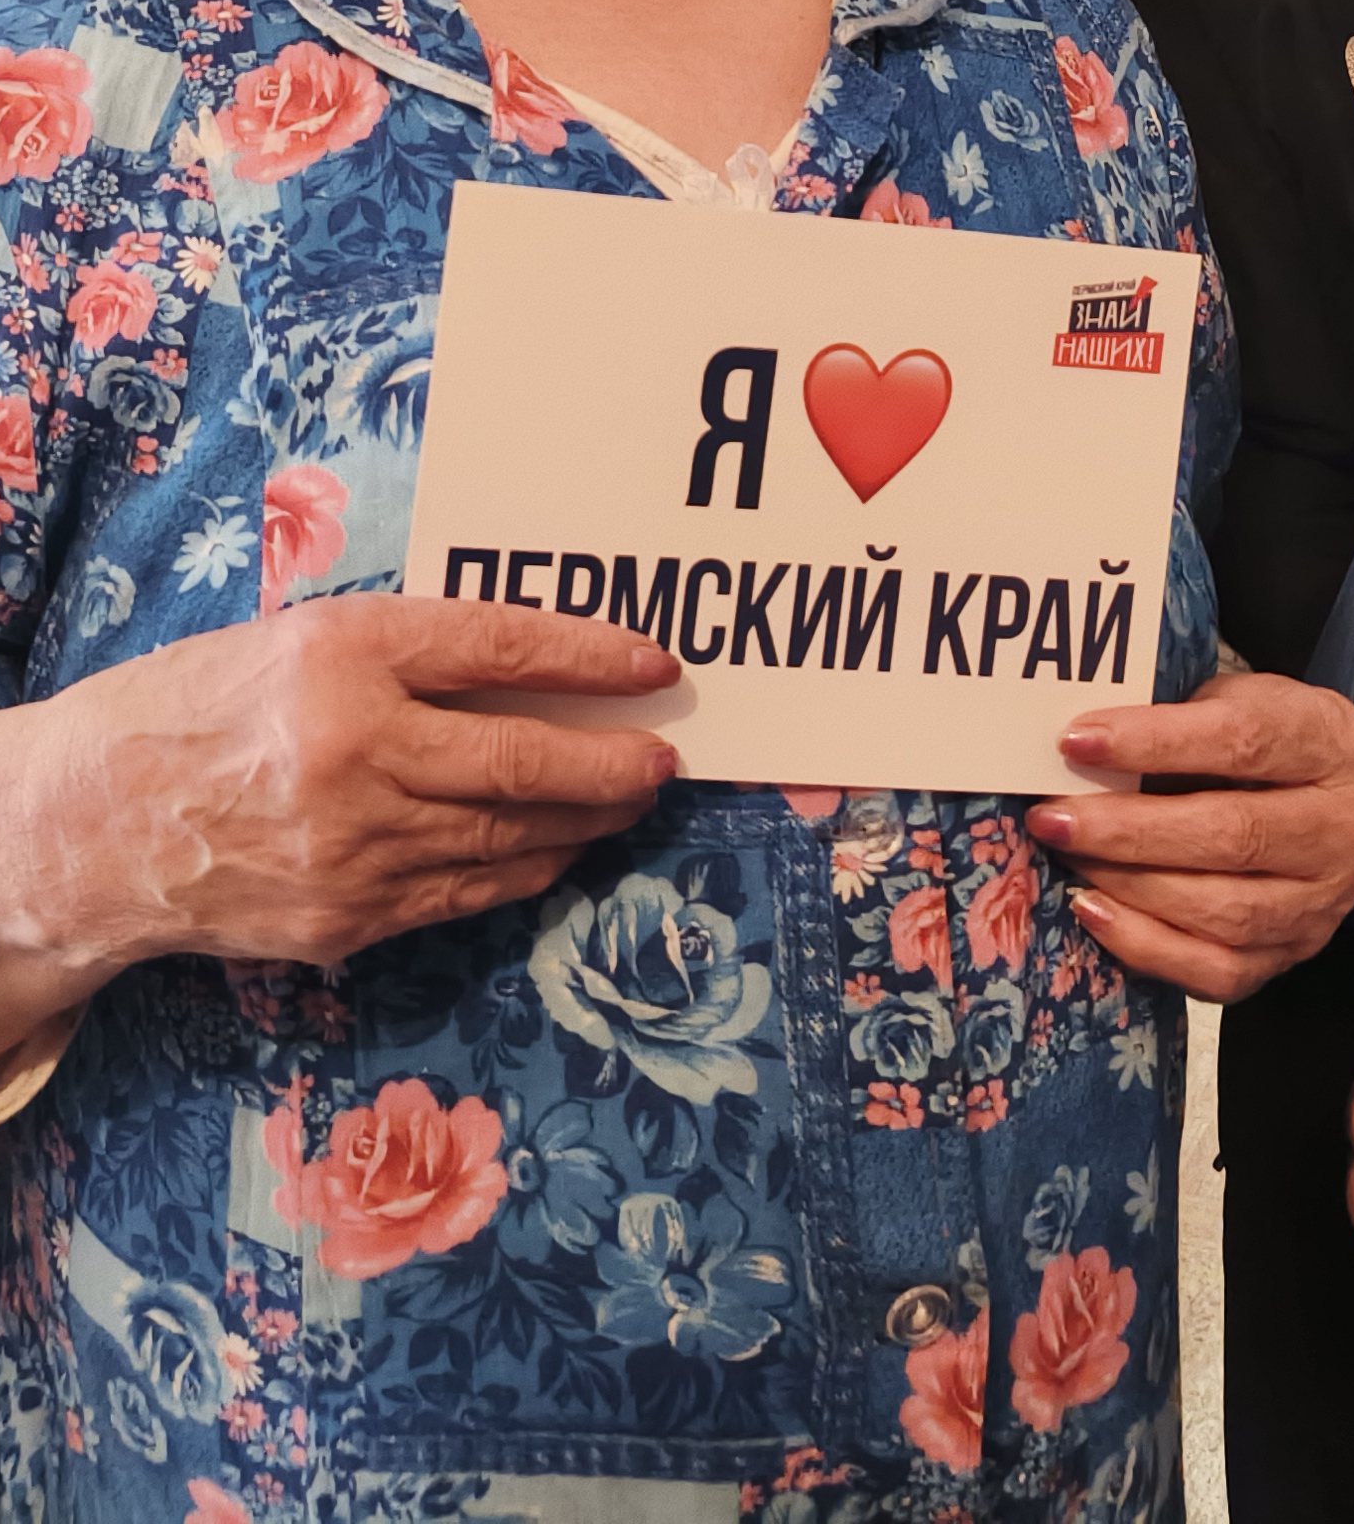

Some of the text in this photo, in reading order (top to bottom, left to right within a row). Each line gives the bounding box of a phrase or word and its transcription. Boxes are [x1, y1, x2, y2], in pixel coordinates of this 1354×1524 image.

[1057, 336, 1155, 371] НАШИХ!
[686, 346, 779, 510] Я
[923, 557, 1136, 684] КРАЙ
